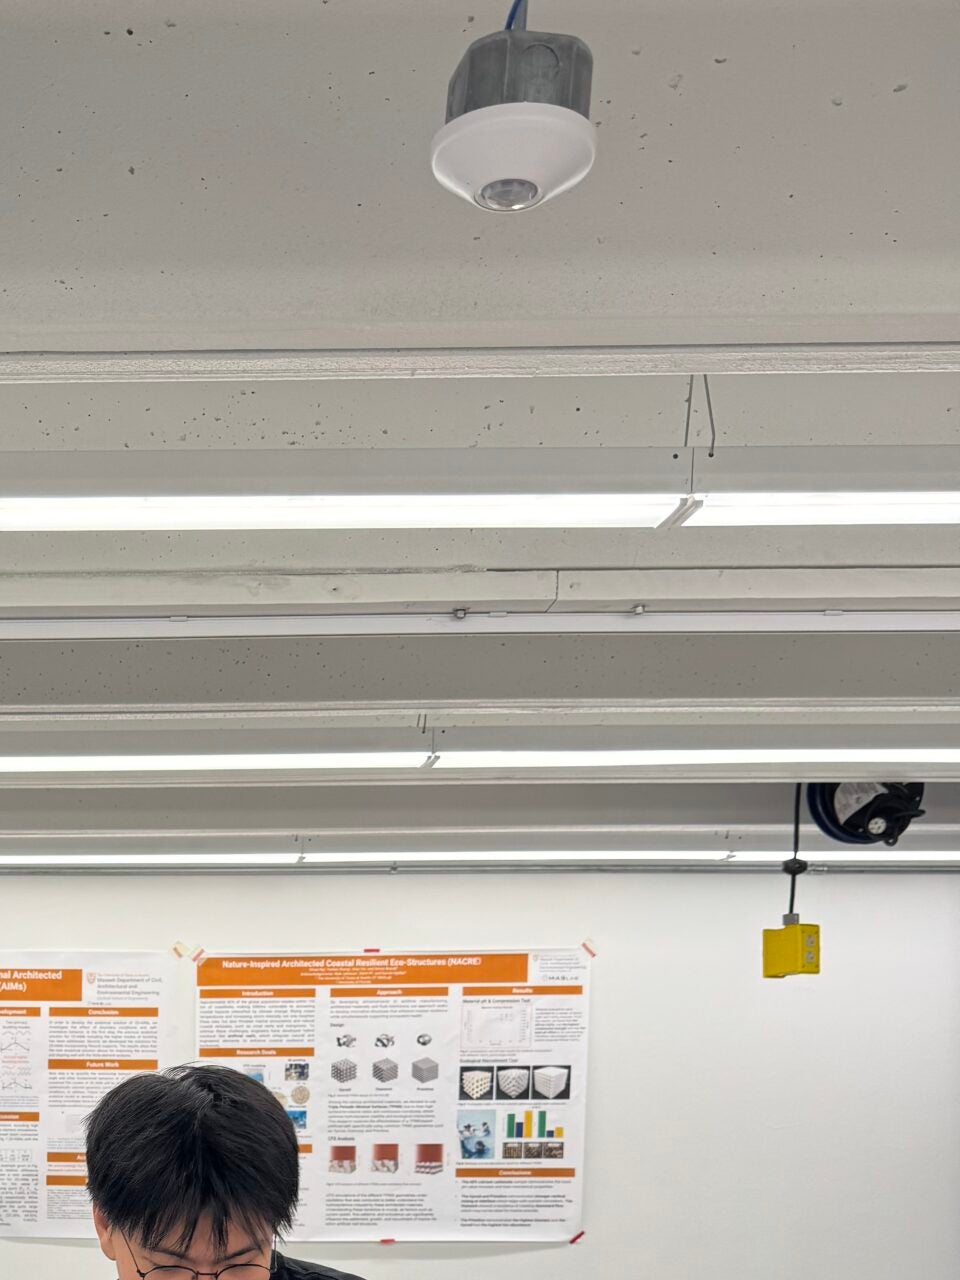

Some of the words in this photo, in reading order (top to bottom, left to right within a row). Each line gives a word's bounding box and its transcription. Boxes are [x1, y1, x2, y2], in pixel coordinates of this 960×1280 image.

[222, 960, 280, 969] Nature-Inspired
[281, 959, 324, 968] Architected
[325, 959, 354, 967] Coastal
[355, 958, 389, 967] Resilient
[390, 958, 446, 967] Eco-Structures
[12, 970, 62, 979] Architected
